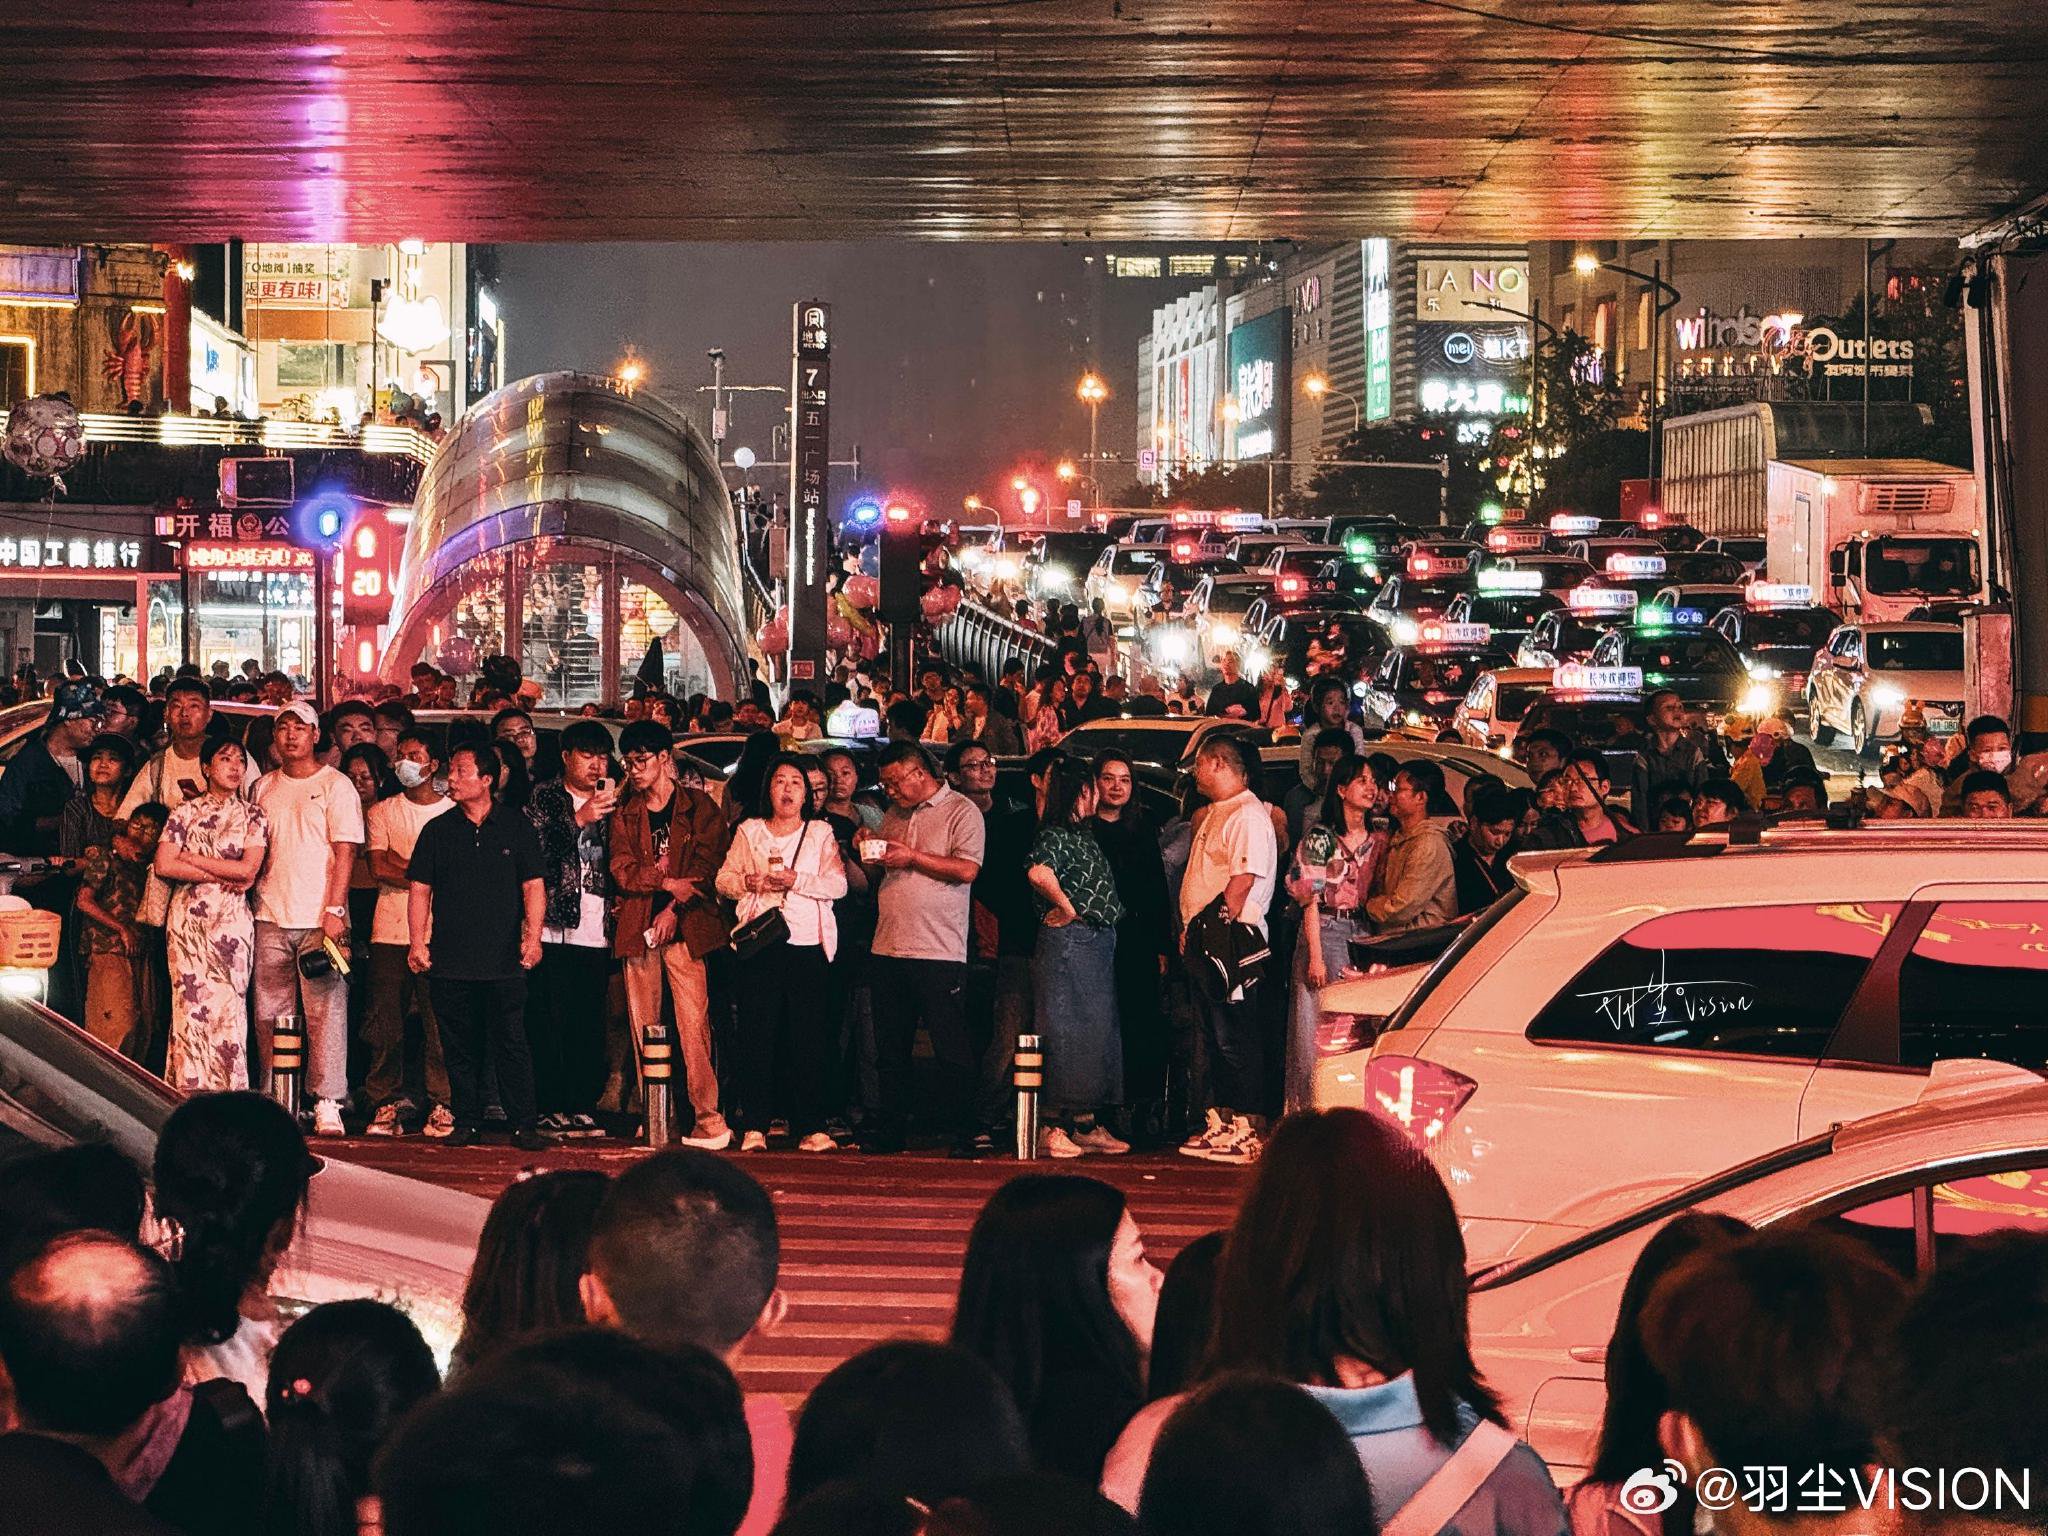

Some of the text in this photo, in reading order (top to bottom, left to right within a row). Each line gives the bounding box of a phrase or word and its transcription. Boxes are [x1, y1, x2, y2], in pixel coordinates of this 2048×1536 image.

[802, 330, 827, 344] 地铁
[1805, 327, 1914, 361] Outlets
[805, 368, 819, 387] 7
[803, 411, 821, 505] 五一广场站
[0, 537, 140, 568] 中国工商银行
[352, 569, 382, 597] 20
